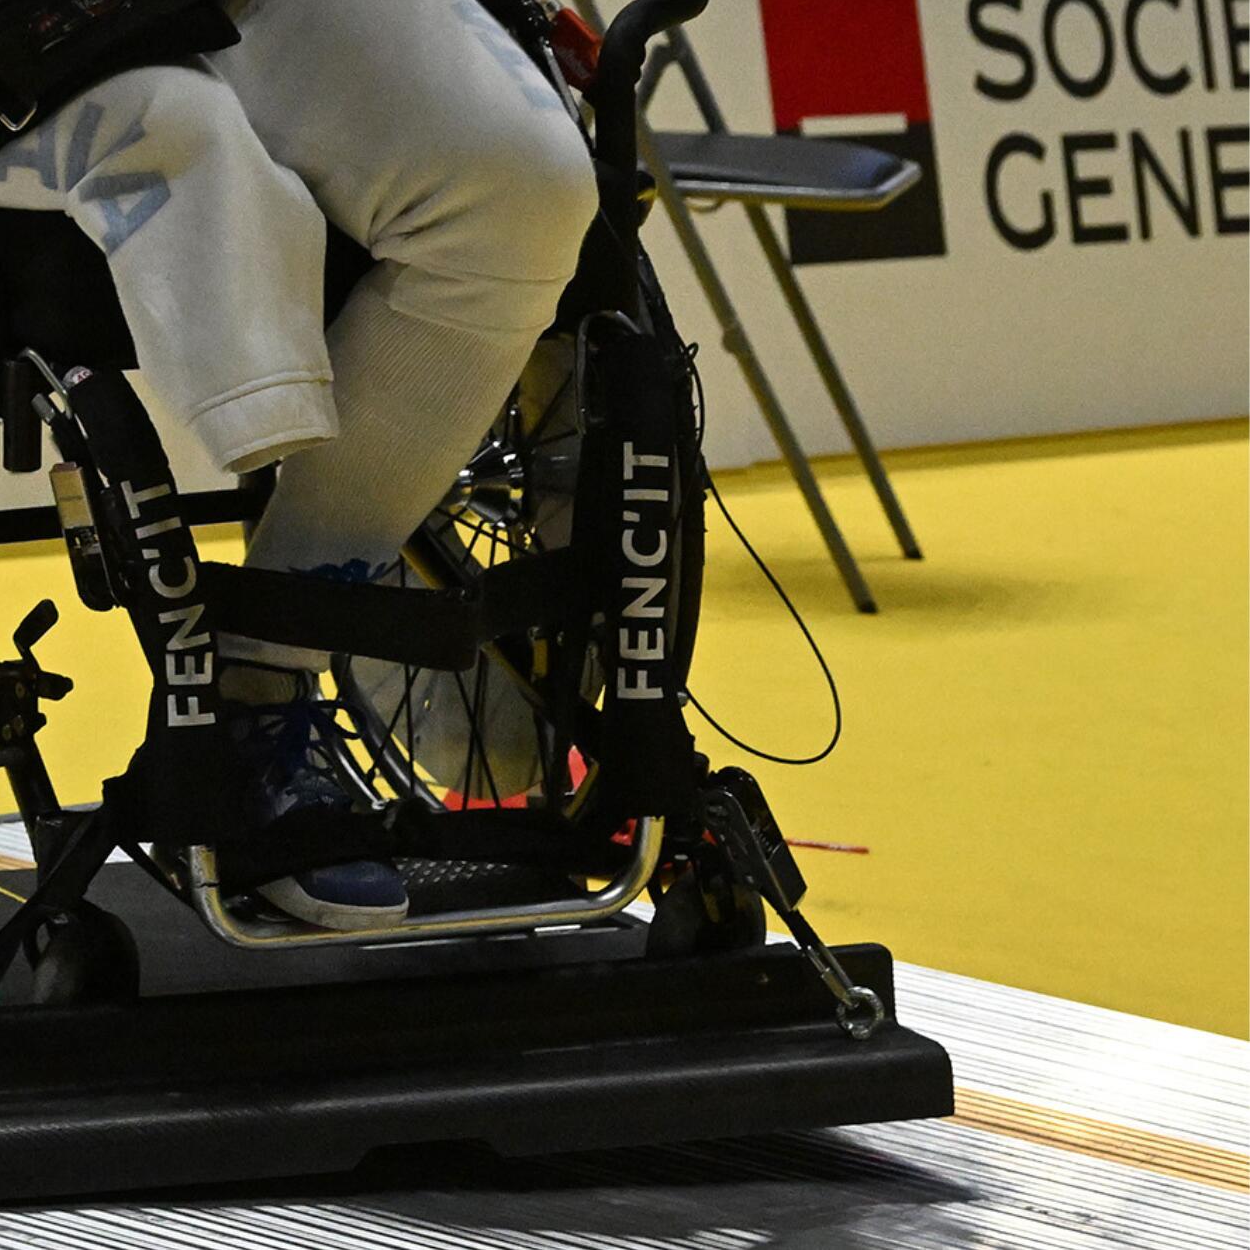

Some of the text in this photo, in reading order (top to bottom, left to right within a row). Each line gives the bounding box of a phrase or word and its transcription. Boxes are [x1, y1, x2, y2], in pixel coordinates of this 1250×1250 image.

[984, 124, 1250, 251] GENE
[120, 479, 217, 728] FENC'IT
[616, 440, 670, 700] FENC'IT
